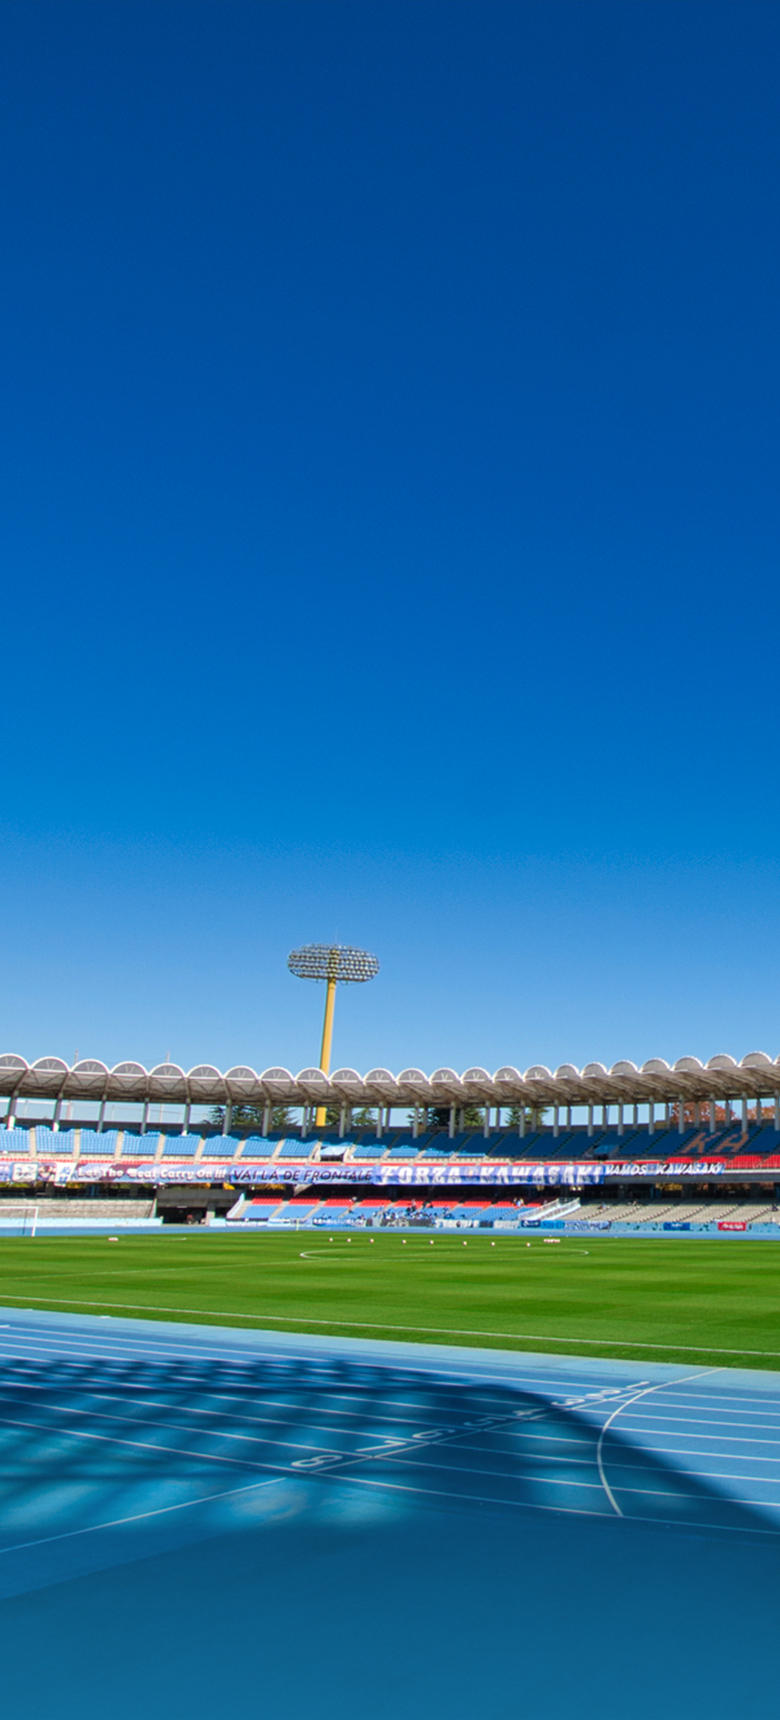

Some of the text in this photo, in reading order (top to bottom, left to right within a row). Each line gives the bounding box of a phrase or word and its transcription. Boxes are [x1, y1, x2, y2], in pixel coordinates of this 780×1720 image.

[102, 1167, 124, 1178] The
[160, 1169, 194, 1181] Carry
[196, 1169, 212, 1179] On
[605, 1163, 647, 1175] VAMOS
[233, 1170, 258, 1180] VAI
[283, 1170, 301, 1181] DE
[303, 1170, 373, 1181] FRONTALE
[379, 1166, 602, 1185] FORZA KAWASAKI
[551, 1398, 585, 1406] 3
[464, 1416, 507, 1427] 5
[412, 1428, 456, 1439] 6
[355, 1440, 407, 1452] 7
[291, 1454, 343, 1467] 8
